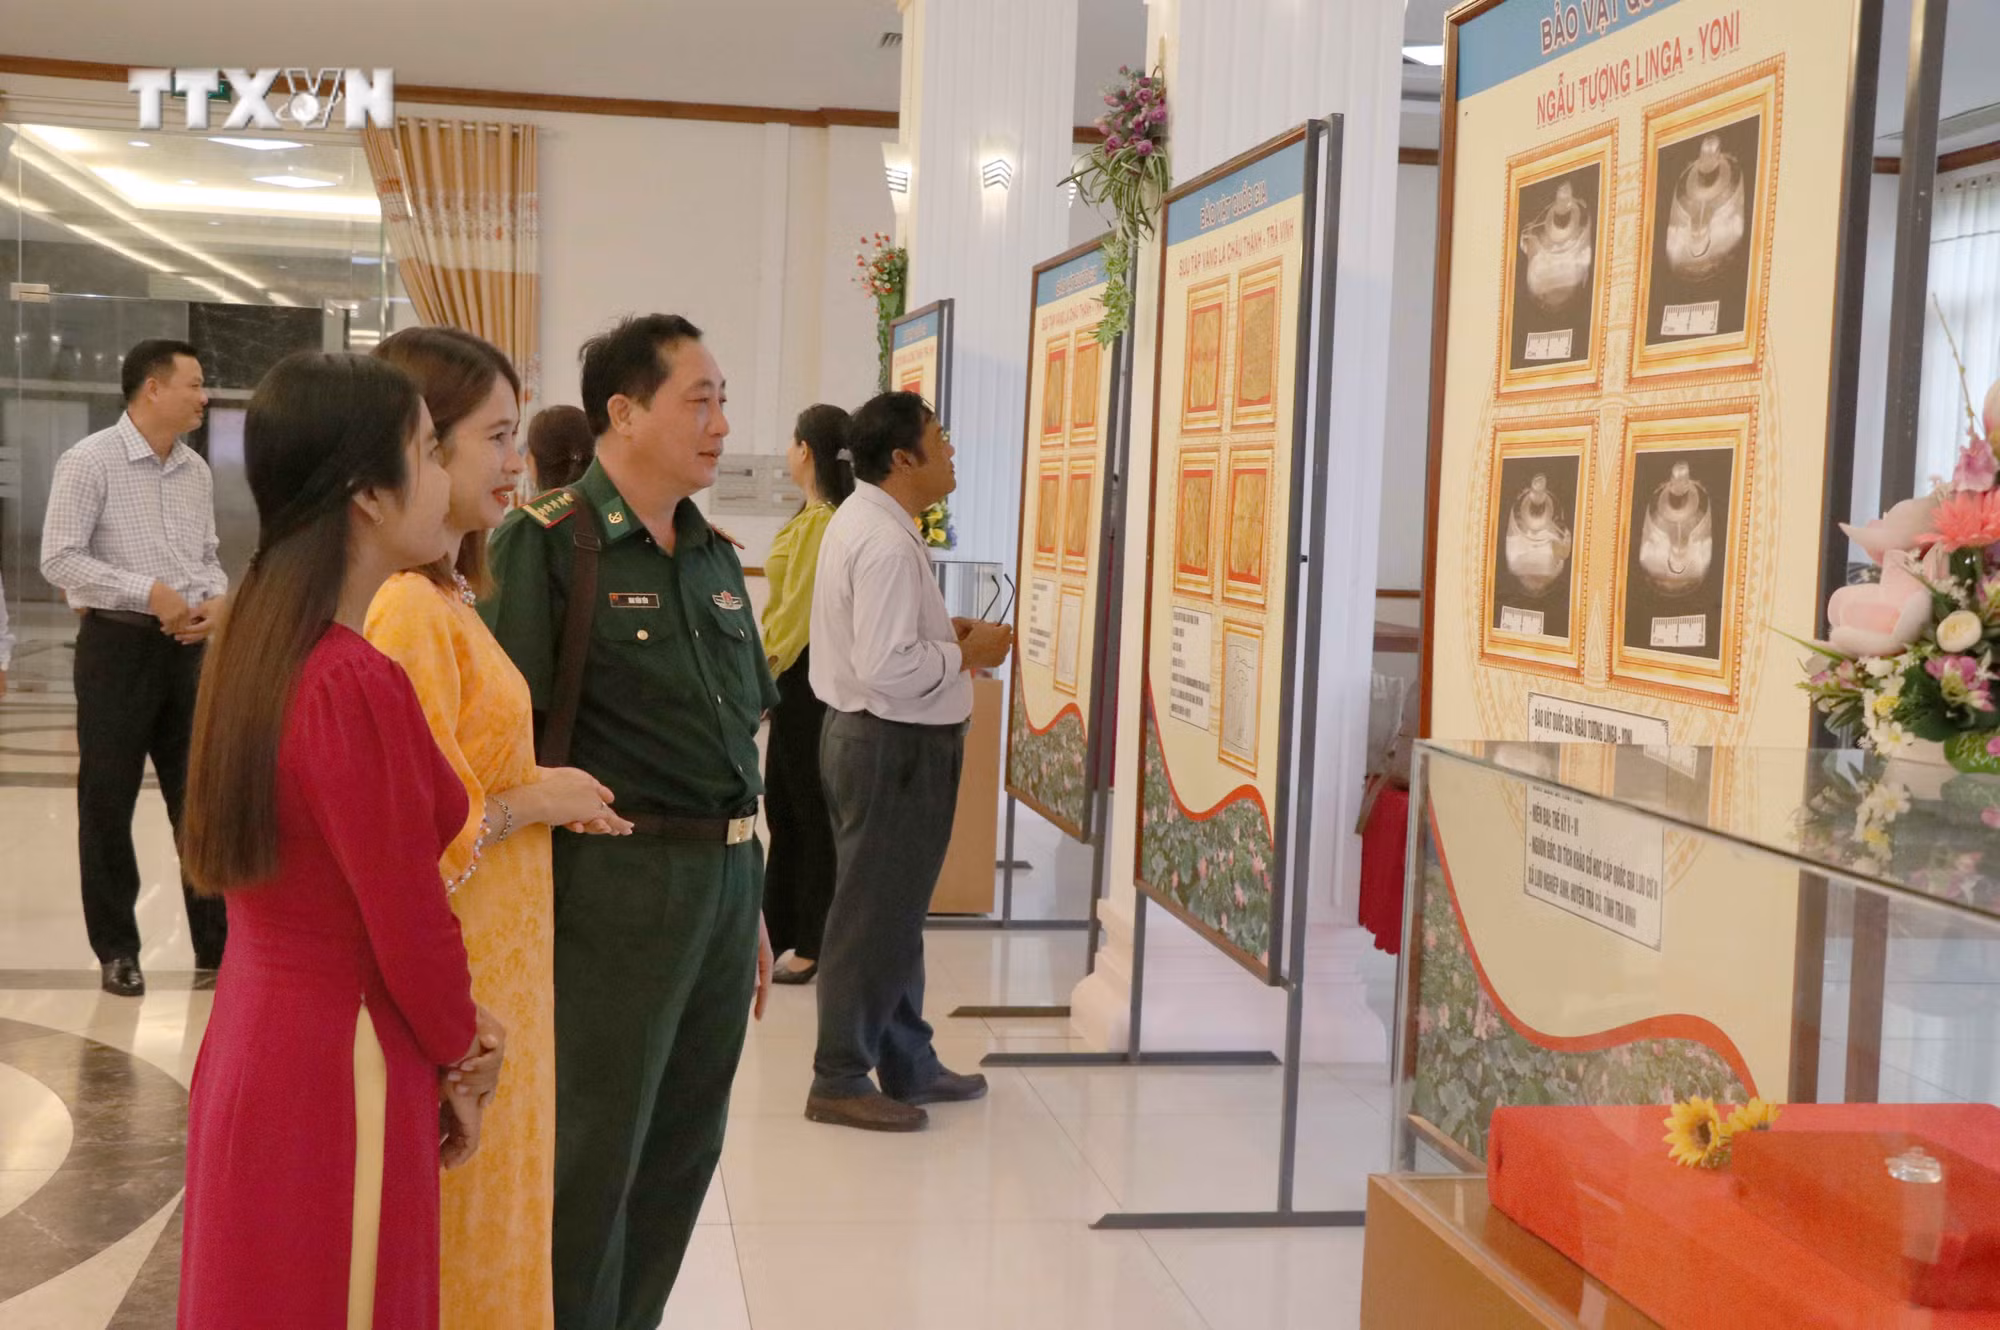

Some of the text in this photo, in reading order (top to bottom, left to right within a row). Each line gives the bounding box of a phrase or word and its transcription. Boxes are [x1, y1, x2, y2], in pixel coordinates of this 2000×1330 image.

[1537, 73, 1574, 125] NGẪU
[1579, 59, 1631, 109] TƯỢNG
[1636, 37, 1682, 87] LINGA
[1699, 9, 1740, 60] YONI
[1541, 1, 1579, 54] BẢO
